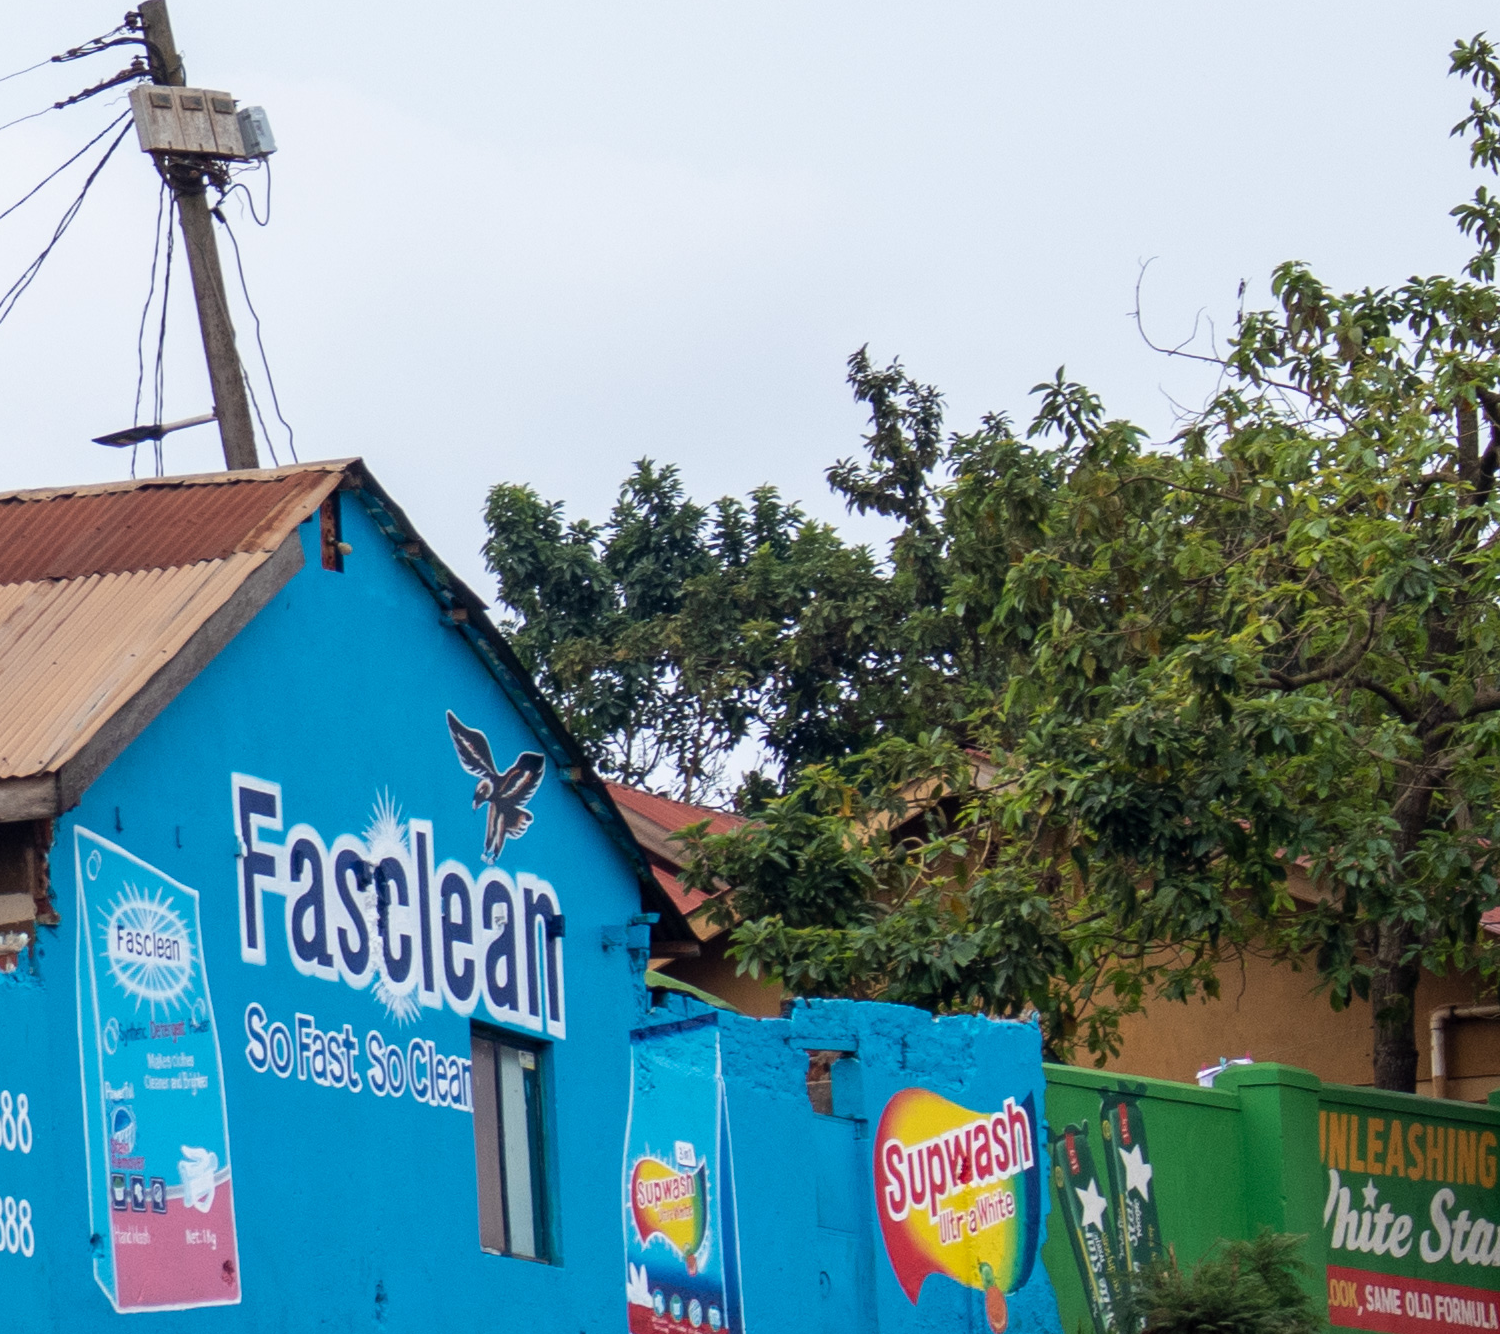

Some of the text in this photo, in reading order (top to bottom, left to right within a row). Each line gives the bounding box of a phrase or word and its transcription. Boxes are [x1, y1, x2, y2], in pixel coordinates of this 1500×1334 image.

[231, 772, 566, 1040] Fasclean
[116, 923, 181, 961] Fasclean
[245, 1002, 293, 1078] So
[295, 1012, 363, 1093] Fast
[366, 1030, 406, 1097] So
[883, 1097, 1034, 1224] Supwash
[637, 1173, 695, 1210] Supwash
[977, 1189, 1015, 1228] White
[1365, 1284, 1402, 1316] SAME
[1405, 1291, 1432, 1320] OLD
[1435, 1295, 1499, 1330] FORMULA
